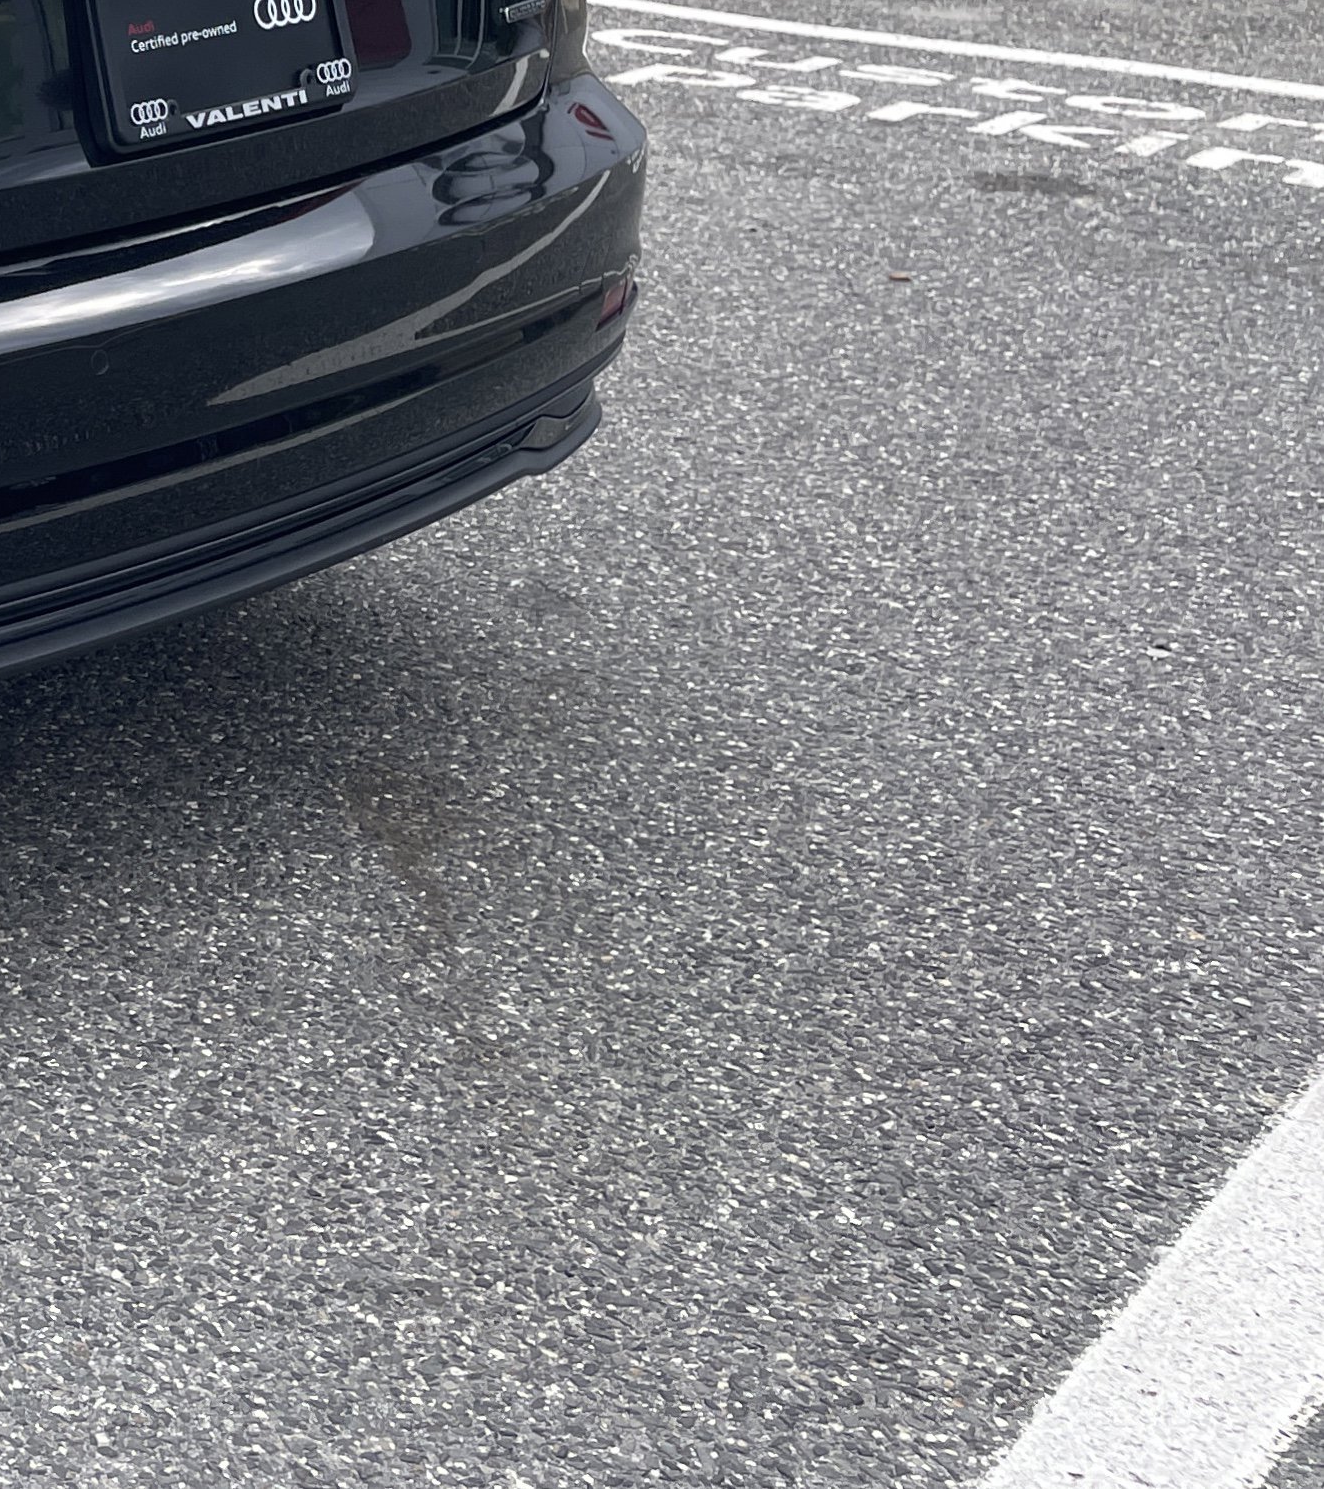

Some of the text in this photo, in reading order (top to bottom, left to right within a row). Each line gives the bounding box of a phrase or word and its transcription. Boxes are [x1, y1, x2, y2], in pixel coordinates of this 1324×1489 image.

[131, 20, 237, 53] Certified pre-owned
[325, 80, 351, 97] Audi
[185, 89, 309, 129] VALENTI
[139, 122, 167, 139] Audi
